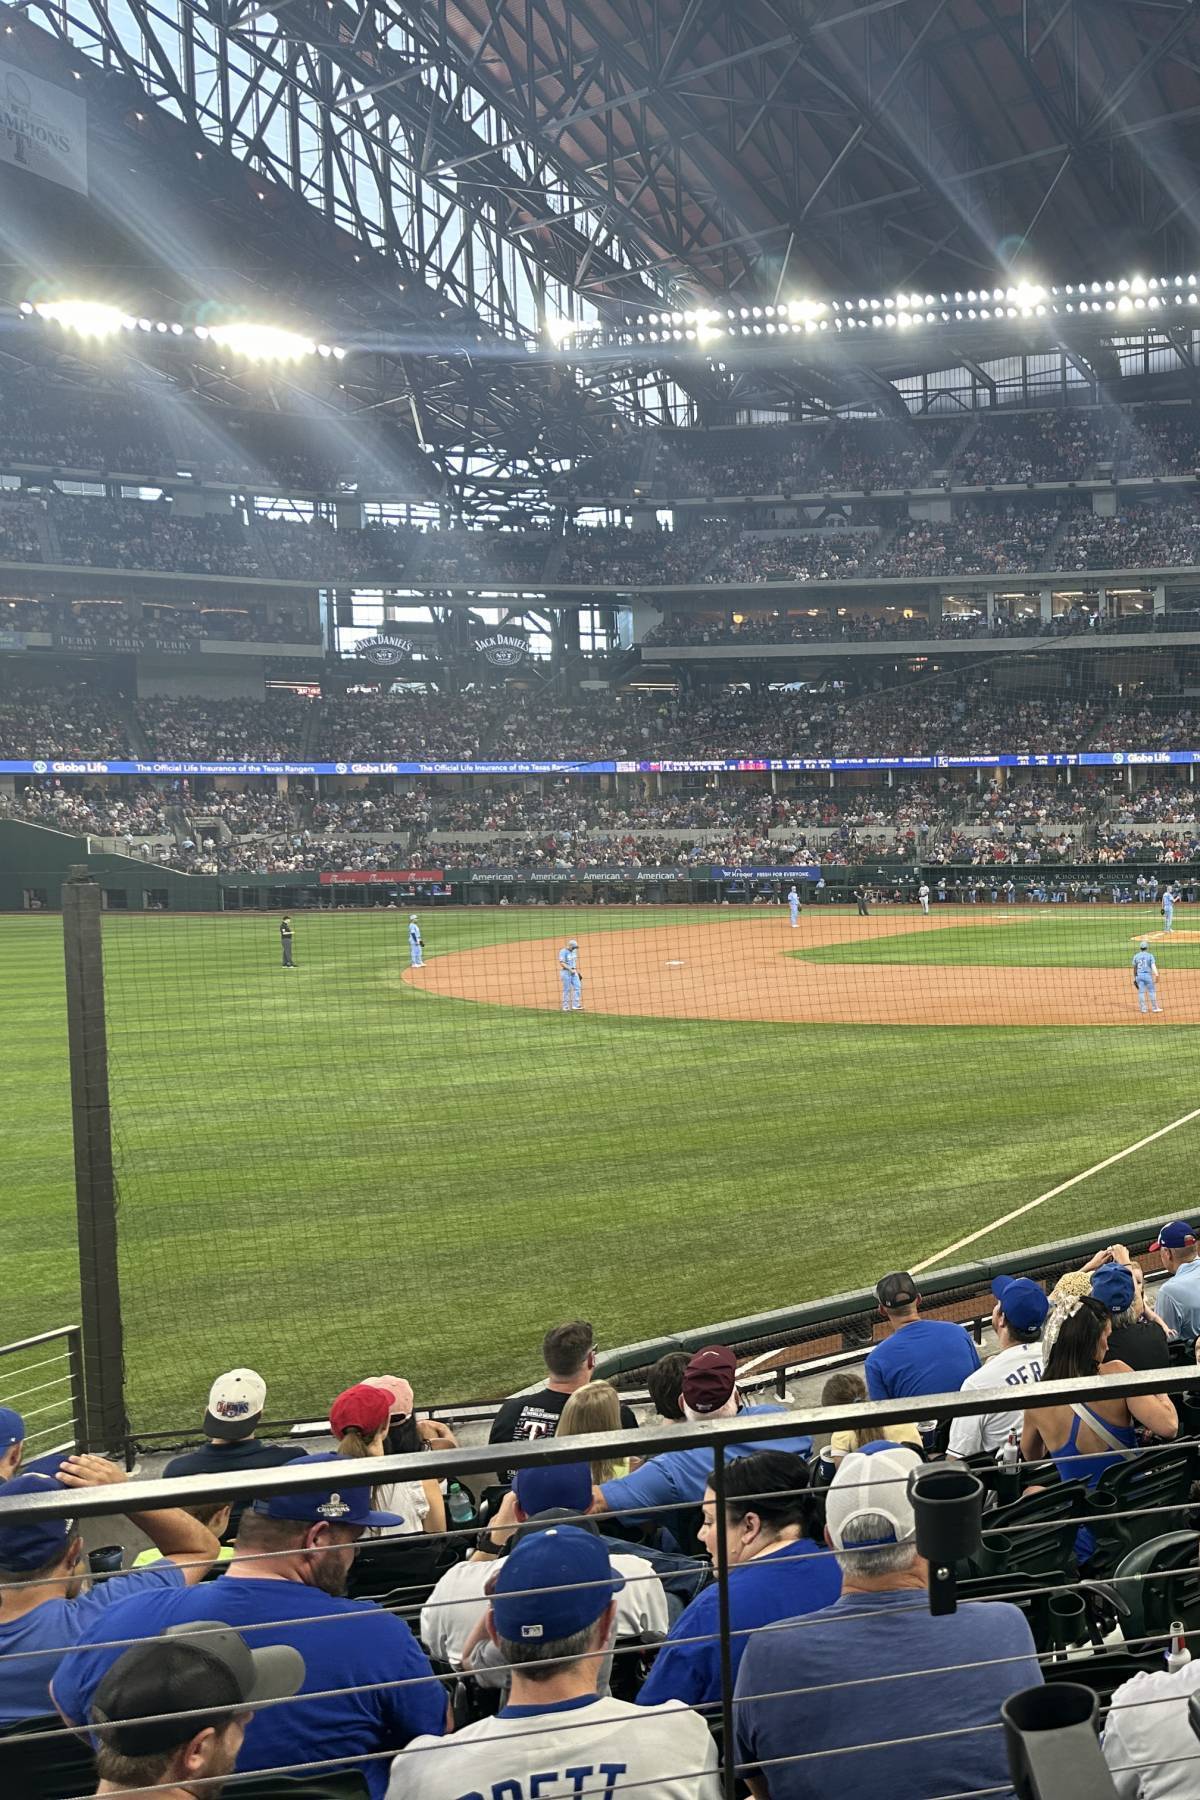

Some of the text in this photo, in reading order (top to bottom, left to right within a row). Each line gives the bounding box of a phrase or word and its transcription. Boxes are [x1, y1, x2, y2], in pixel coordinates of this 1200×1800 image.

[59, 635, 98, 646] PERRY
[108, 638, 146, 649] PERRY
[155, 640, 193, 650] PERRY
[356, 638, 378, 652] JACK
[474, 637, 497, 653] JACK
[1127, 753, 1171, 763] Globe Life
[52, 762, 109, 773] Globe Life
[135, 763, 315, 774] The Official Life Insurance of the Texas Rangers
[352, 763, 398, 773] Globe Life
[419, 764, 432, 772] The
[434, 764, 459, 772] Official
[460, 763, 473, 772] Life
[475, 763, 506, 772] Insurance
[507, 763, 515, 772] of
[516, 763, 529, 772] the
[530, 763, 550, 771] Texas
[472, 872, 513, 881] American
[530, 872, 567, 880] American
[584, 872, 620, 880] American
[637, 871, 675, 880] American
[731, 868, 753, 879] Kroger
